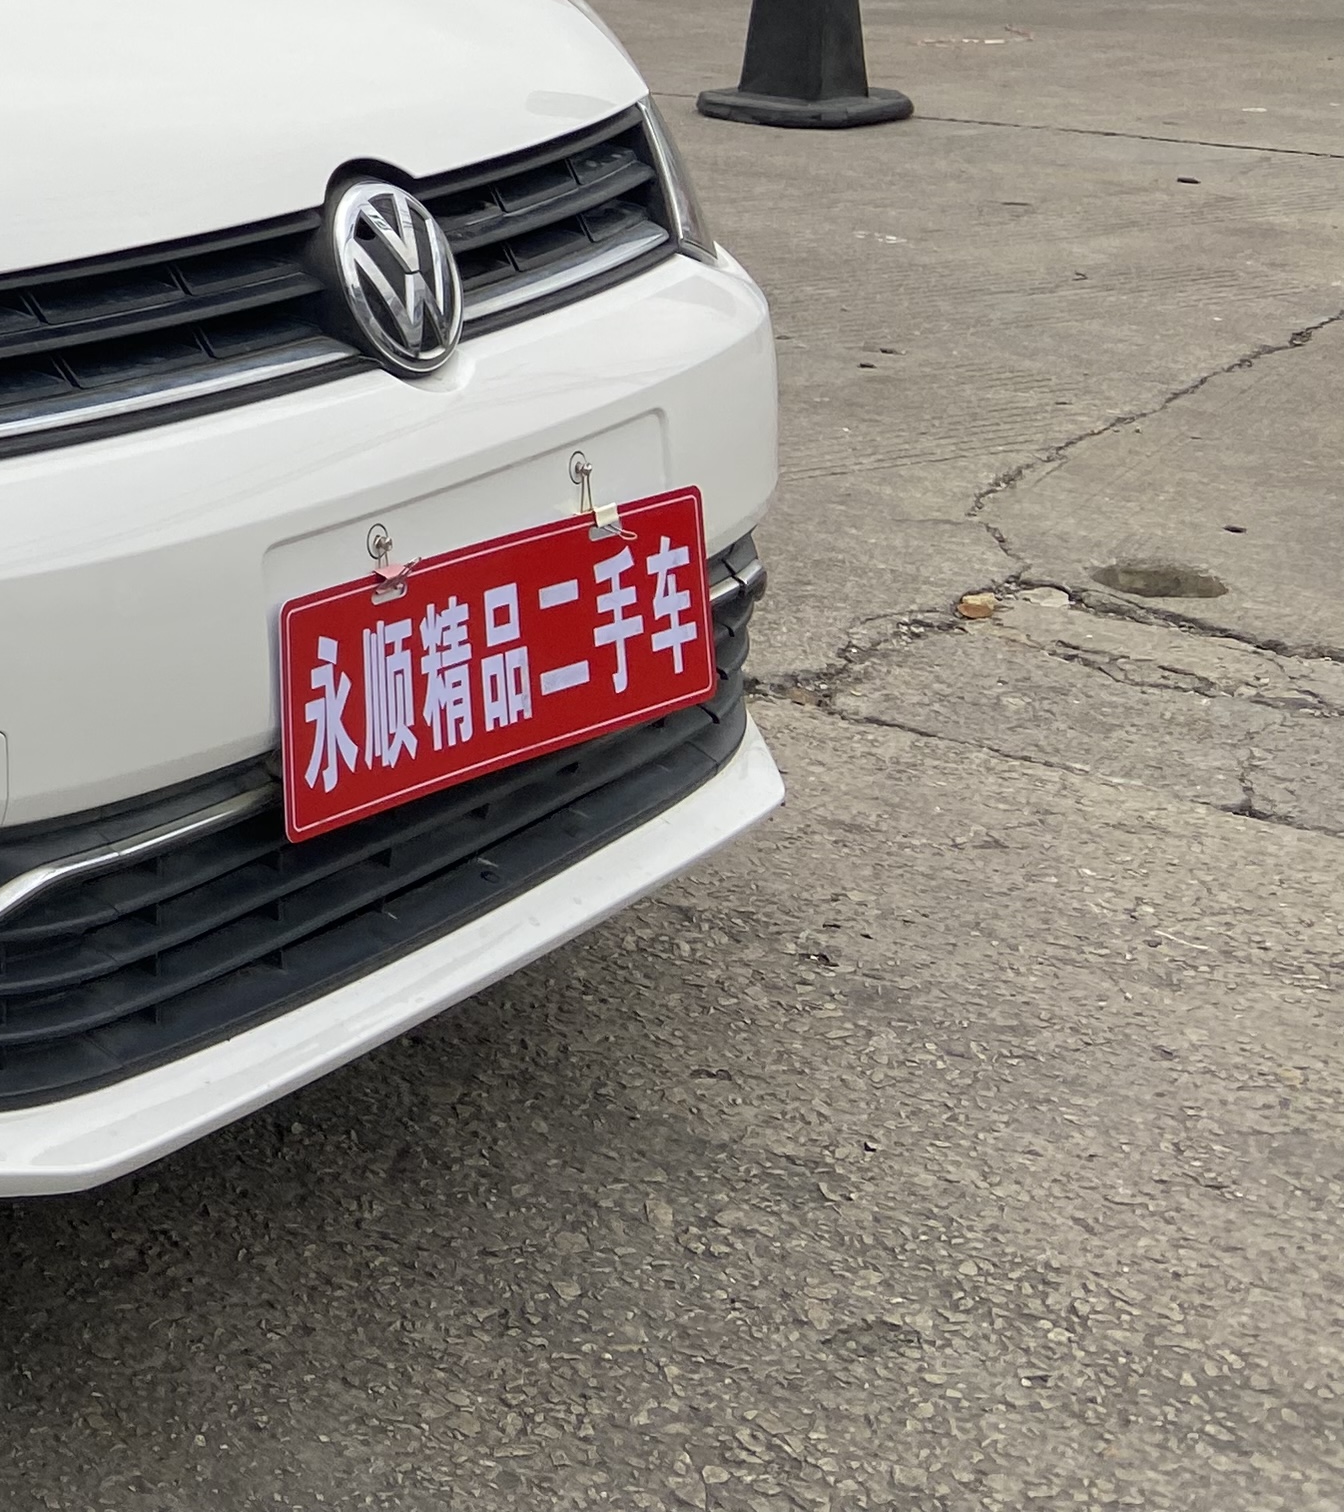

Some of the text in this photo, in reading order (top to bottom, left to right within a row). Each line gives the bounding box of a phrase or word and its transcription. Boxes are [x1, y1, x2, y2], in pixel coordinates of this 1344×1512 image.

[303, 535, 698, 794] 永顺精品二手车
